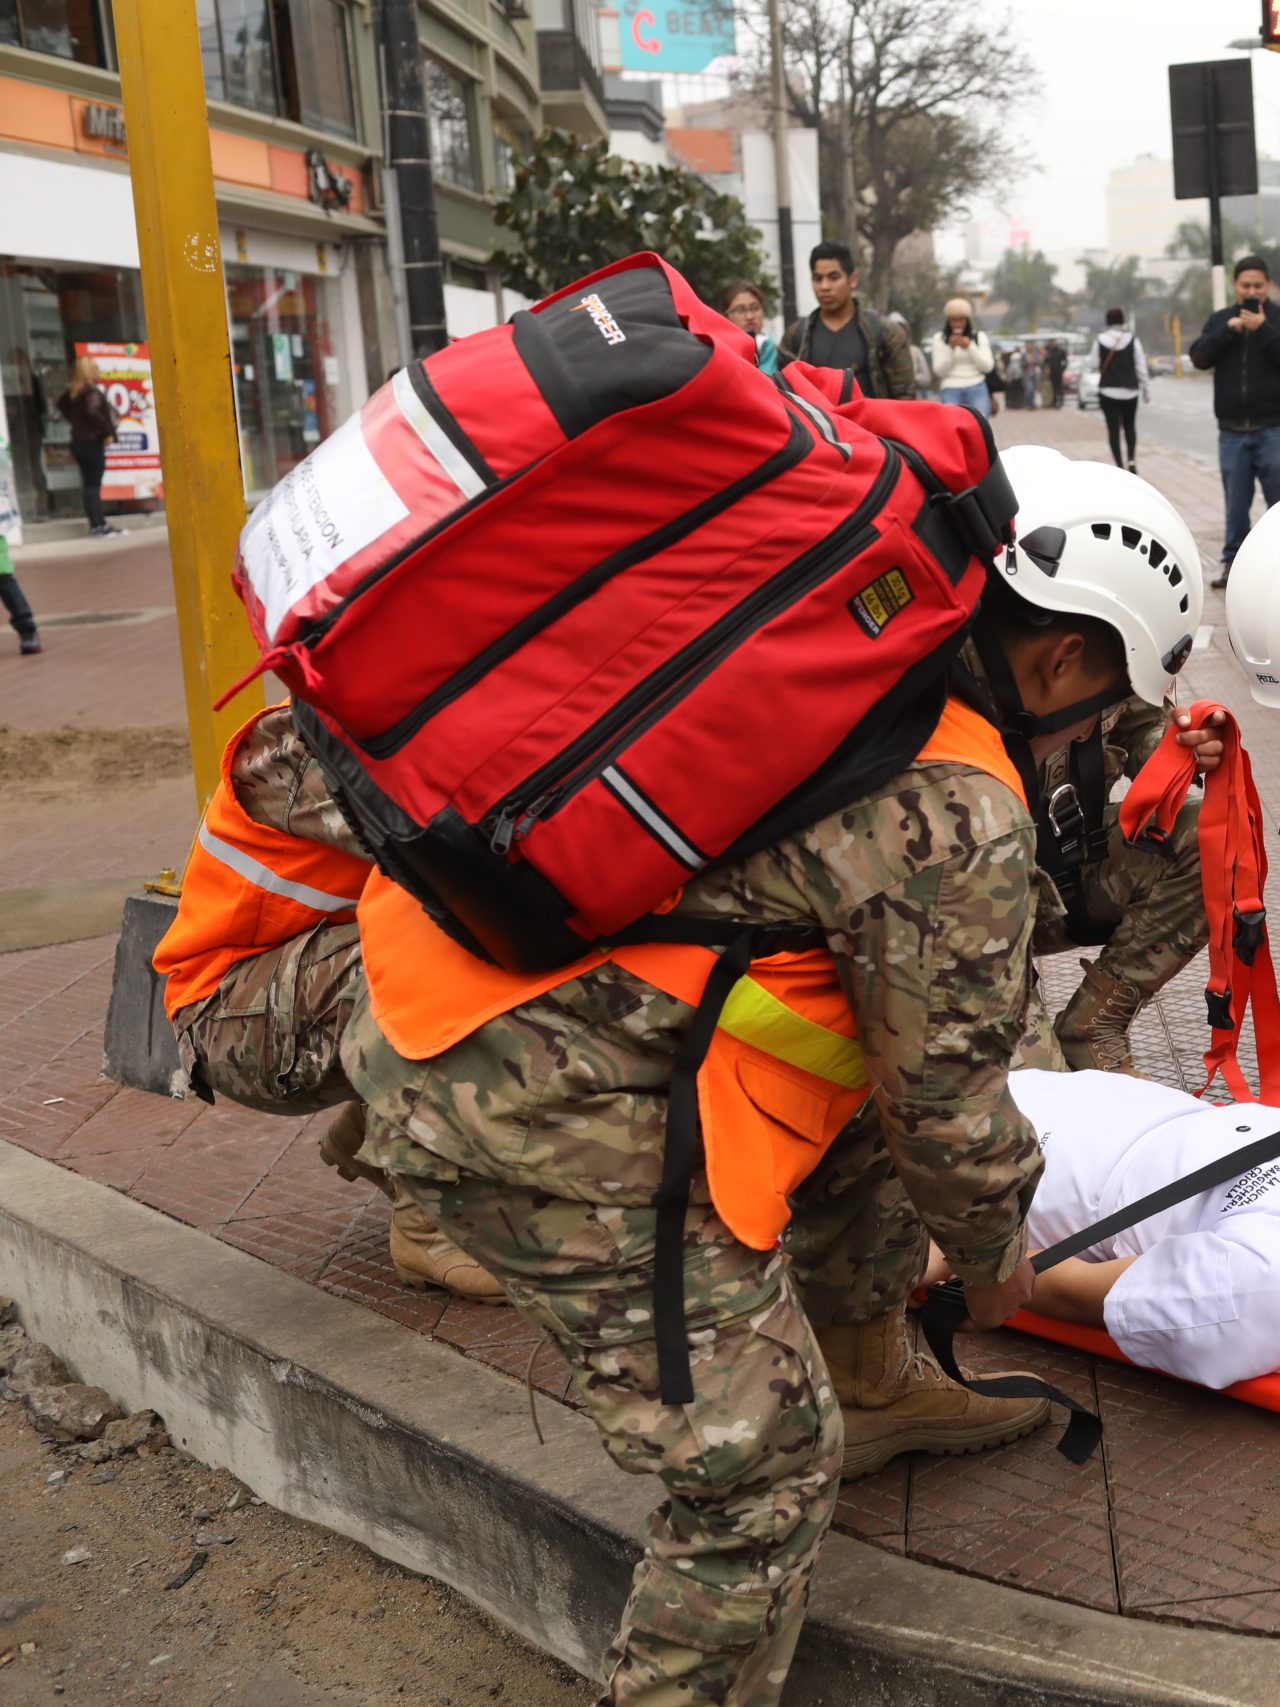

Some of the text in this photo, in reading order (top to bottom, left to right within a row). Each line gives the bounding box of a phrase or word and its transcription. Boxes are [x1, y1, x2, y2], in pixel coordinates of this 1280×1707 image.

[1225, 1167, 1263, 1199] CRIOLLA
[1237, 1177, 1280, 1207] LA LUCHA
